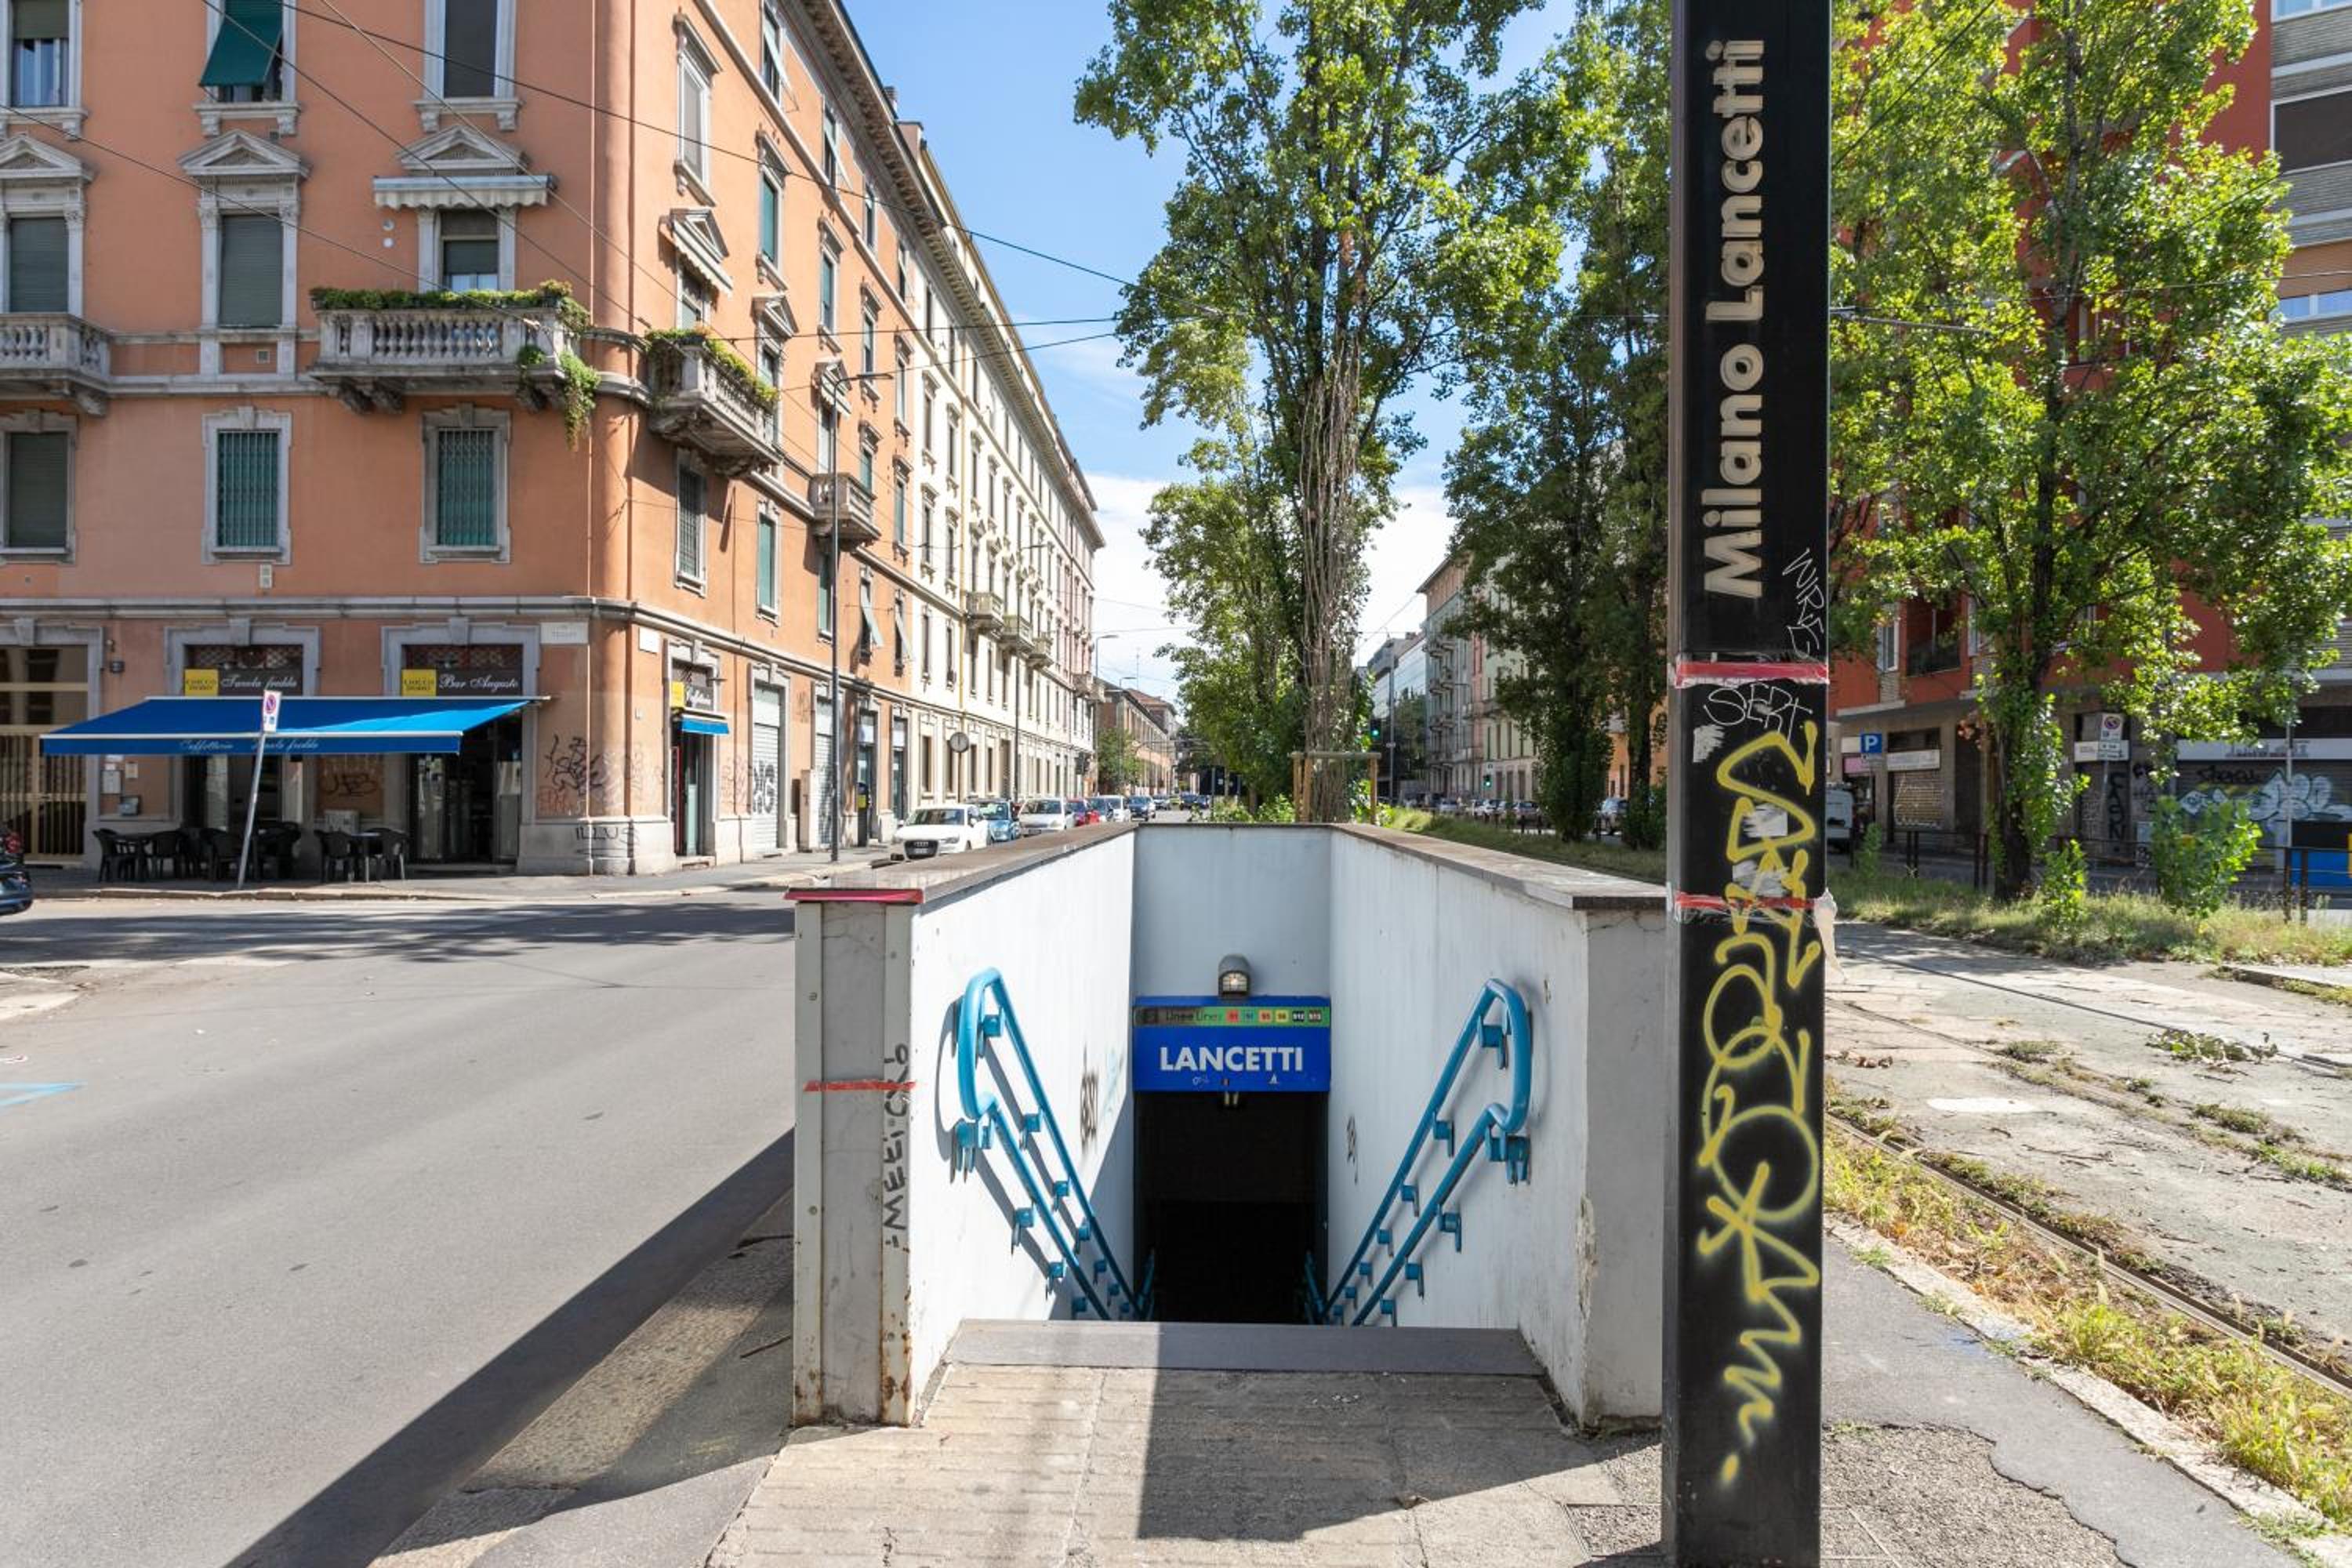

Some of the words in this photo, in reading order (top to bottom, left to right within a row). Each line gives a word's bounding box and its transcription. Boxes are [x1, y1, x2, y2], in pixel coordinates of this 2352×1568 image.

[1705, 40, 1764, 321] Lancetti
[1701, 343, 1763, 599] Milano
[439, 673, 466, 688] Bar
[1864, 735, 1878, 752] P
[1160, 1047, 1303, 1072] LANCETTI
